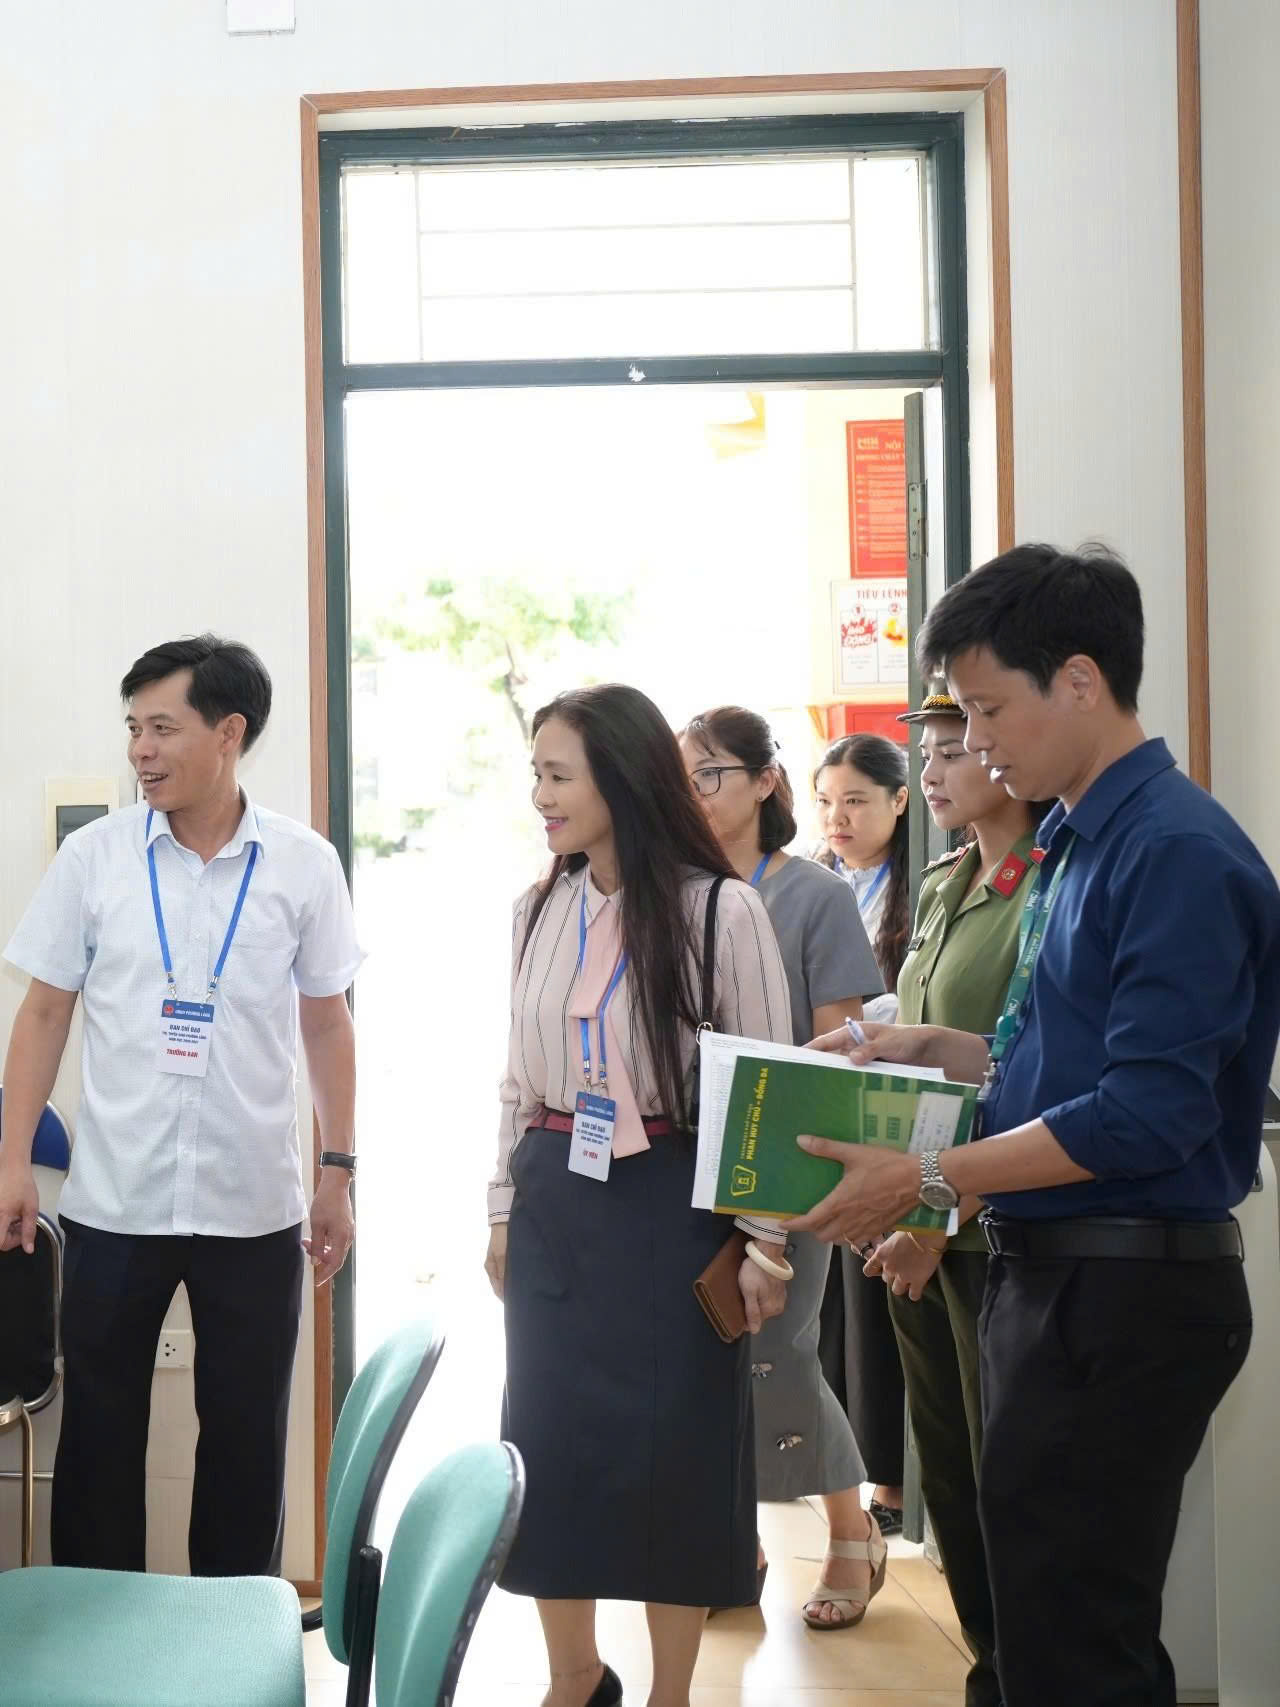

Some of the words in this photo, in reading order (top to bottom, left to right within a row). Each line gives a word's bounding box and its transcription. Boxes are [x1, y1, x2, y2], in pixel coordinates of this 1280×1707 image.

[752, 1106, 761, 1121] CHÚ
[751, 1123, 759, 1138] HUY
[746, 1139, 756, 1160] PHAN
